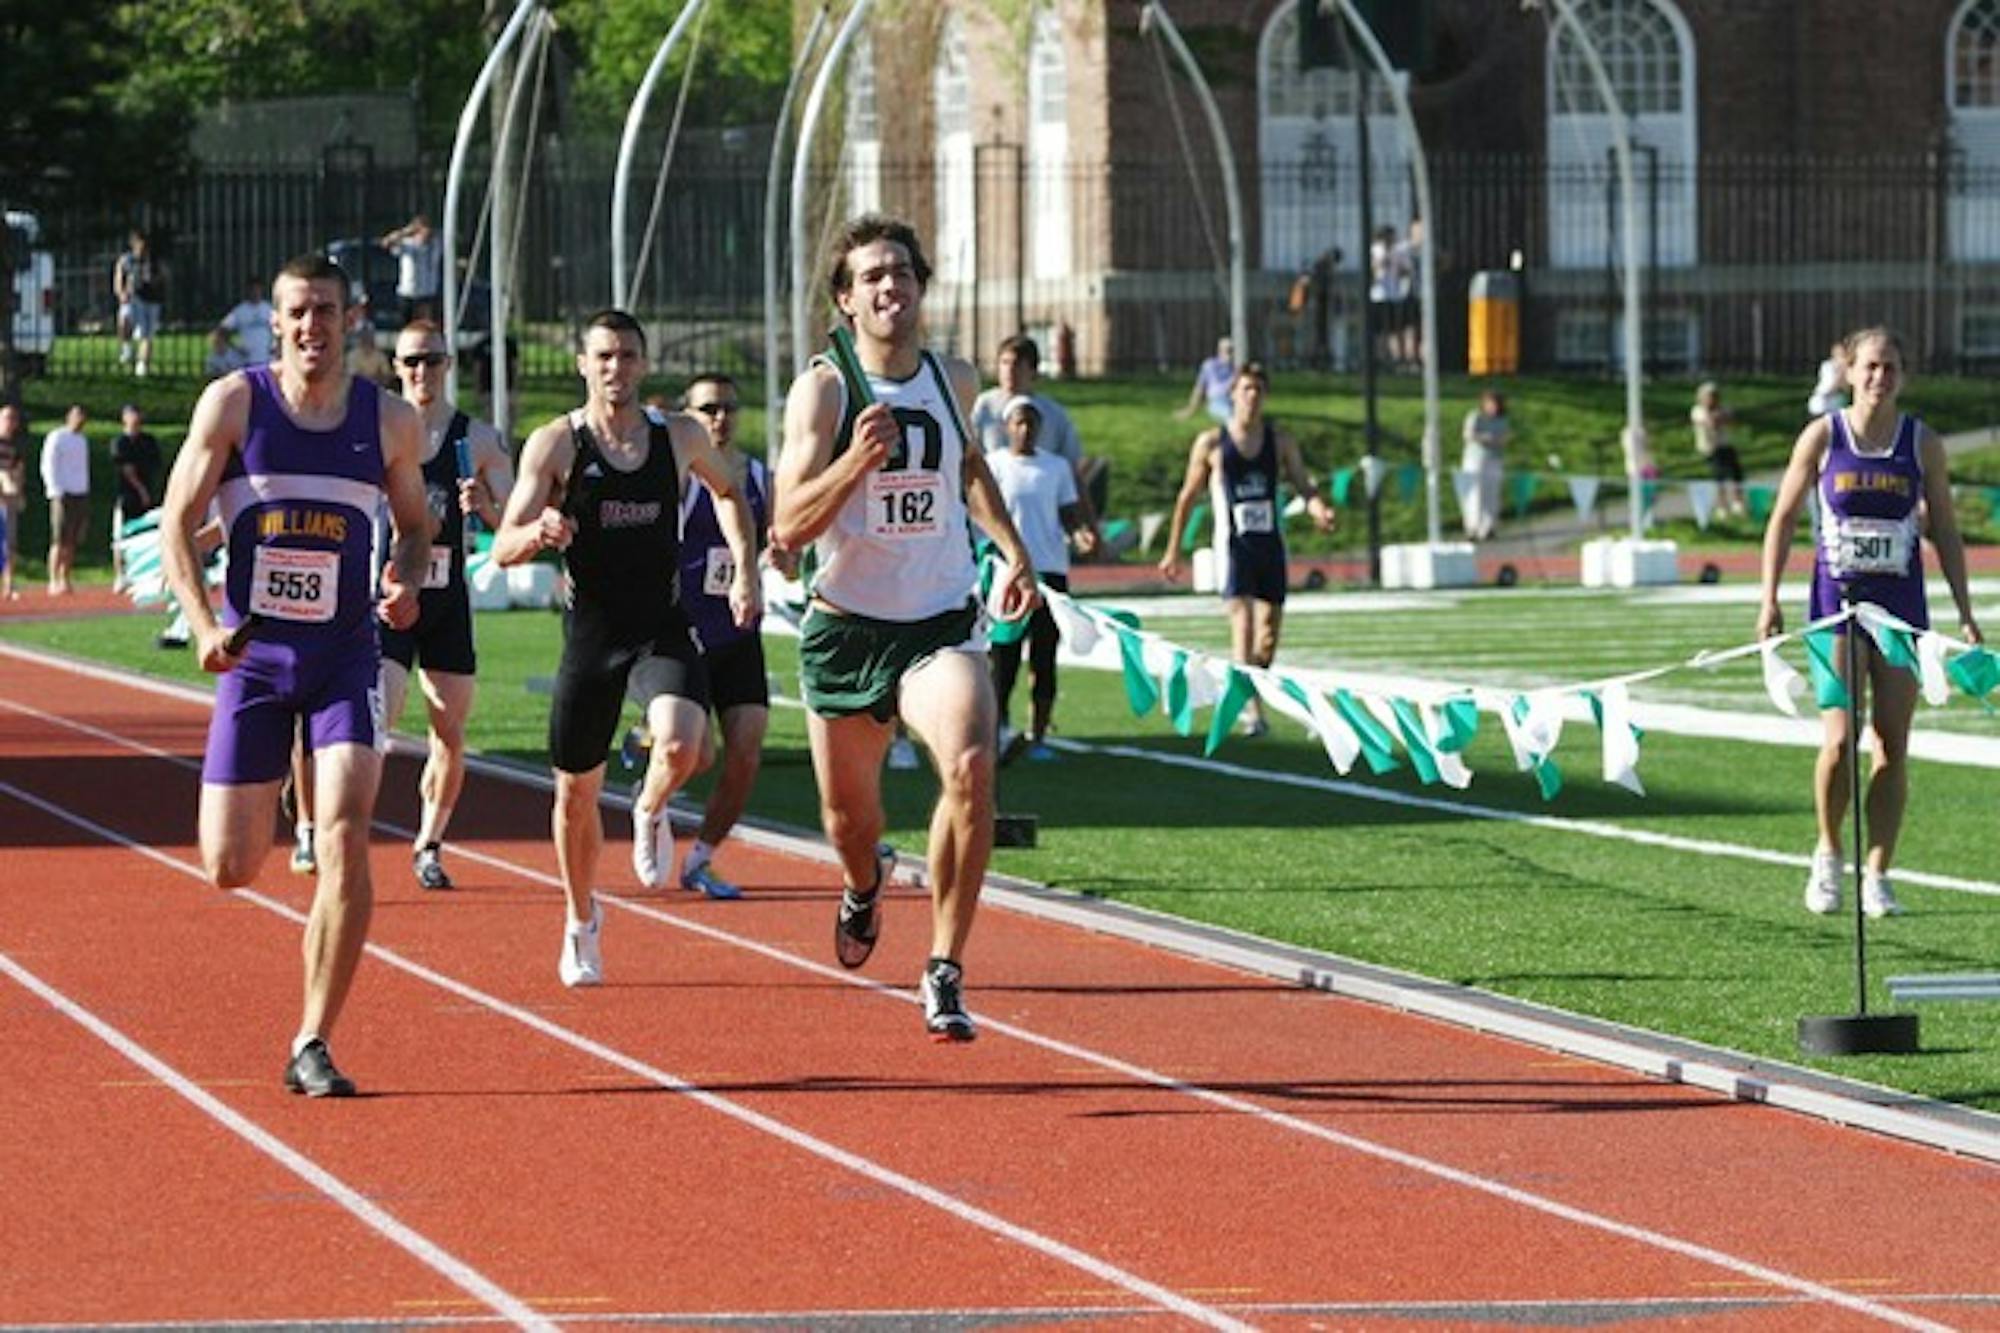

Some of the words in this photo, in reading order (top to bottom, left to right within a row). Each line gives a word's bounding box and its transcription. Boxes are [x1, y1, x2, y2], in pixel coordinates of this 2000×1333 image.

[1834, 472, 1909, 496] WILLIAMS
[883, 491, 933, 523] 162
[258, 510, 346, 541] WILLIAMS
[1853, 536, 1892, 558] 501
[267, 571, 321, 601] 553
